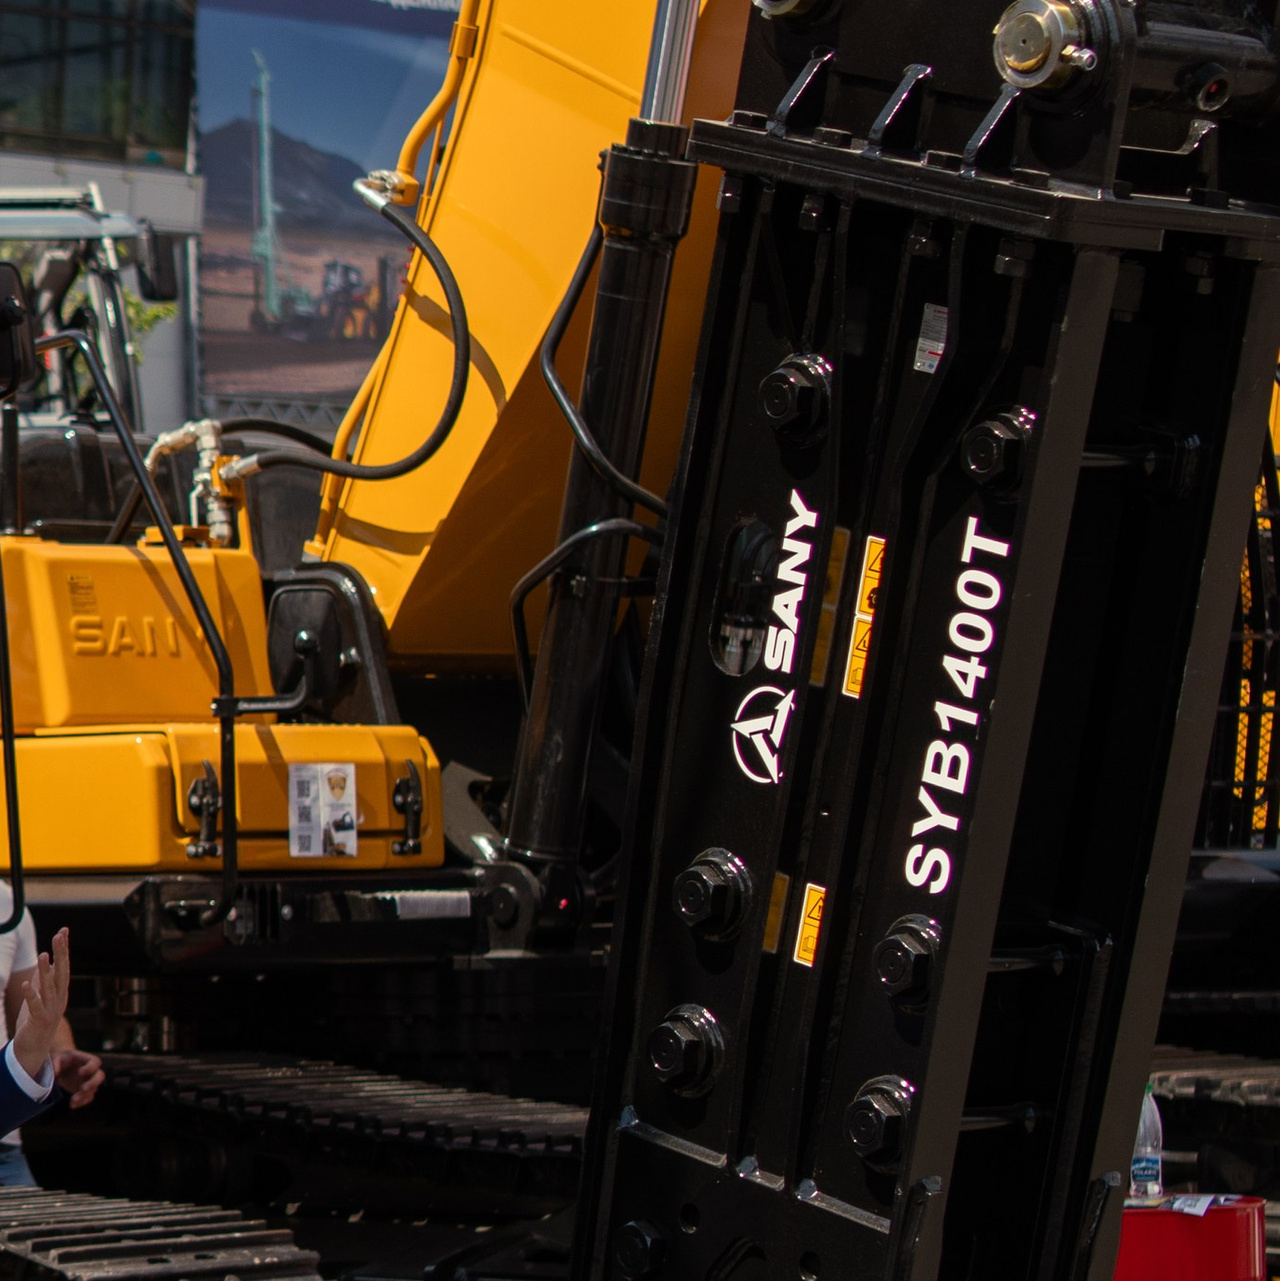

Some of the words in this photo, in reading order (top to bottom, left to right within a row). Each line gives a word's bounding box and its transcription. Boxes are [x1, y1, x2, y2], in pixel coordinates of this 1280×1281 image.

[70, 615, 203, 657] SAN
[766, 489, 818, 673] SANY
[905, 517, 1010, 894] SYB1400T
